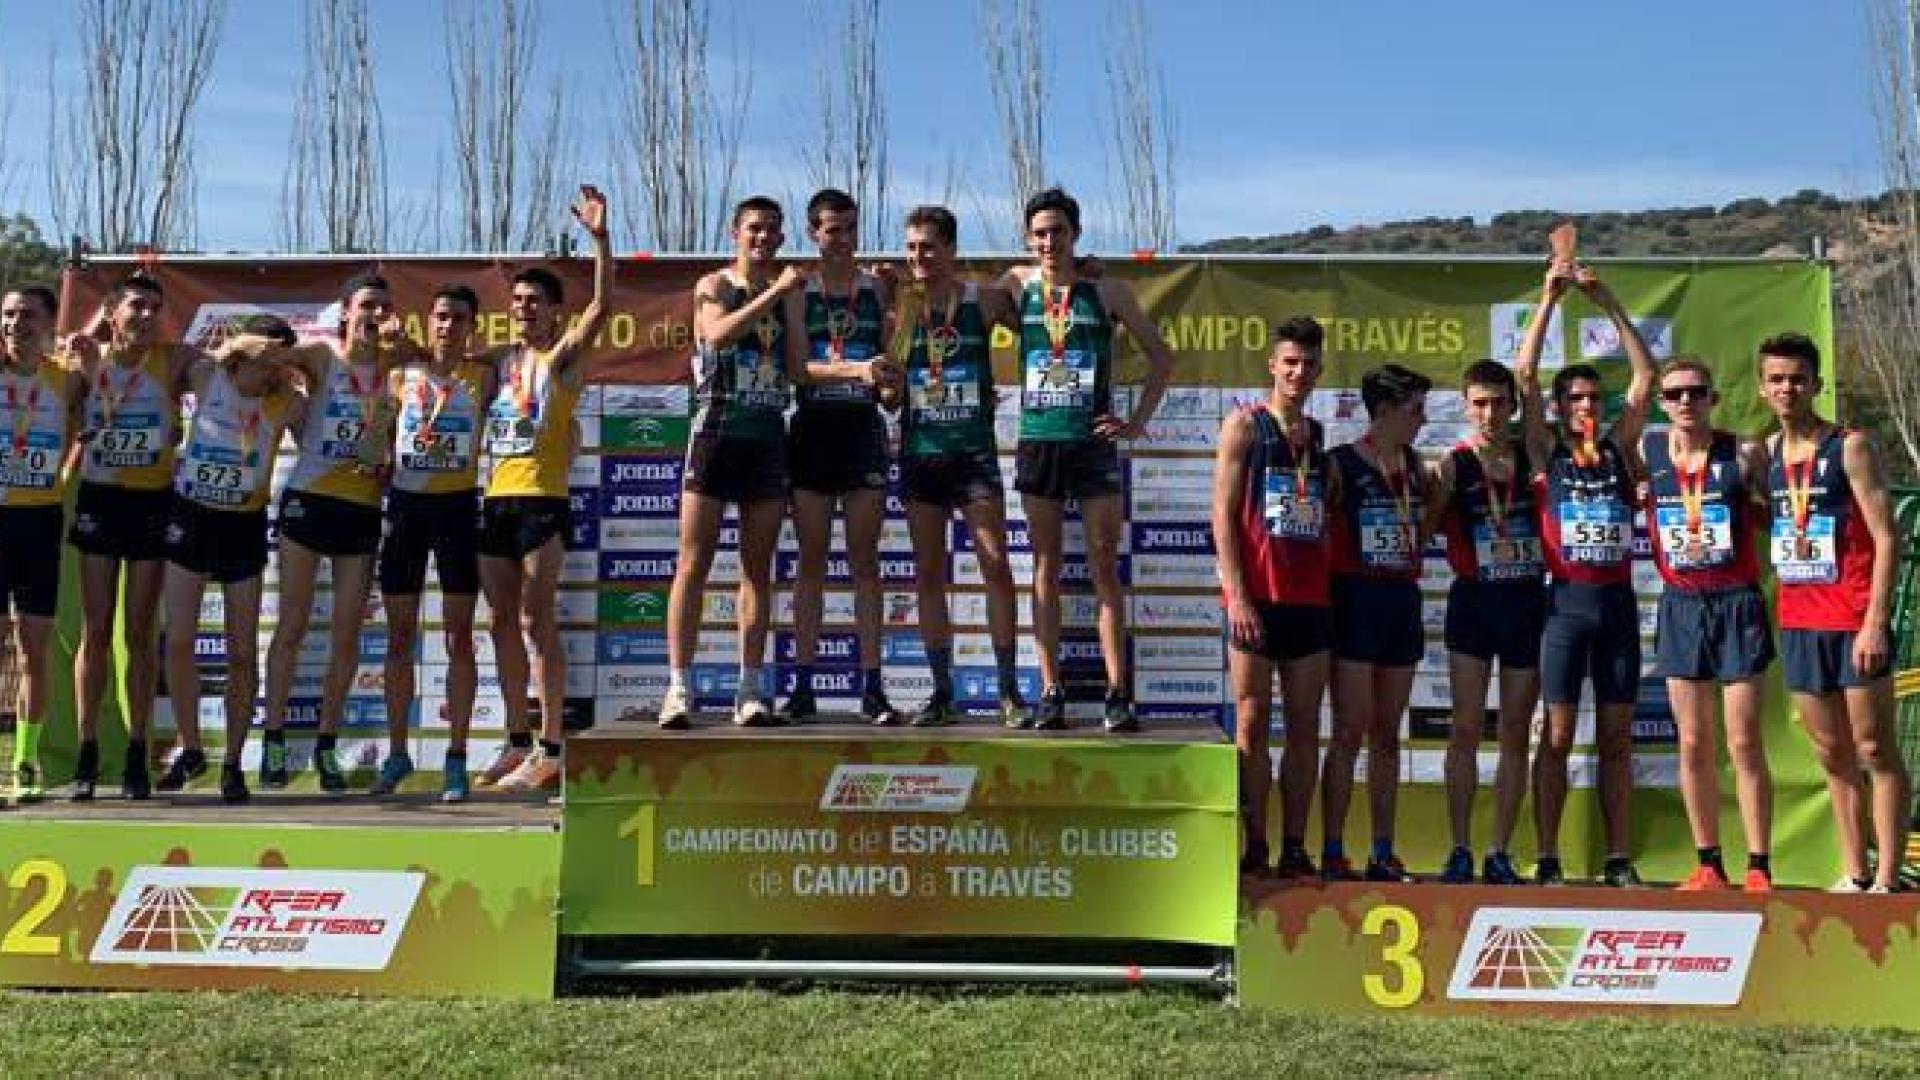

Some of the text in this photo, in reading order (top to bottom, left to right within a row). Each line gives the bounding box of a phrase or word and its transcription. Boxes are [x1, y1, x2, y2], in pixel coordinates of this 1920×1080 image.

[649, 314, 688, 348] de
[102, 431, 149, 450] 672
[197, 463, 243, 488] 673
[1574, 522, 1621, 544] 534
[618, 804, 655, 886] 1
[665, 827, 838, 854] CAMPEONATO
[847, 828, 883, 852] de
[890, 820, 1010, 855] ESPAÑA
[1060, 828, 1178, 859] CLUBES
[749, 865, 783, 896] de
[792, 863, 909, 897] CAMPO
[944, 861, 1074, 897] TRAVÉS
[0, 860, 67, 956] 2
[229, 917, 387, 935] ATLETISMO
[217, 936, 309, 953] CROSS
[1361, 904, 1425, 1008] 3
[1578, 956, 1734, 972] ATLETISMO
[1571, 974, 1658, 990] CROSS
